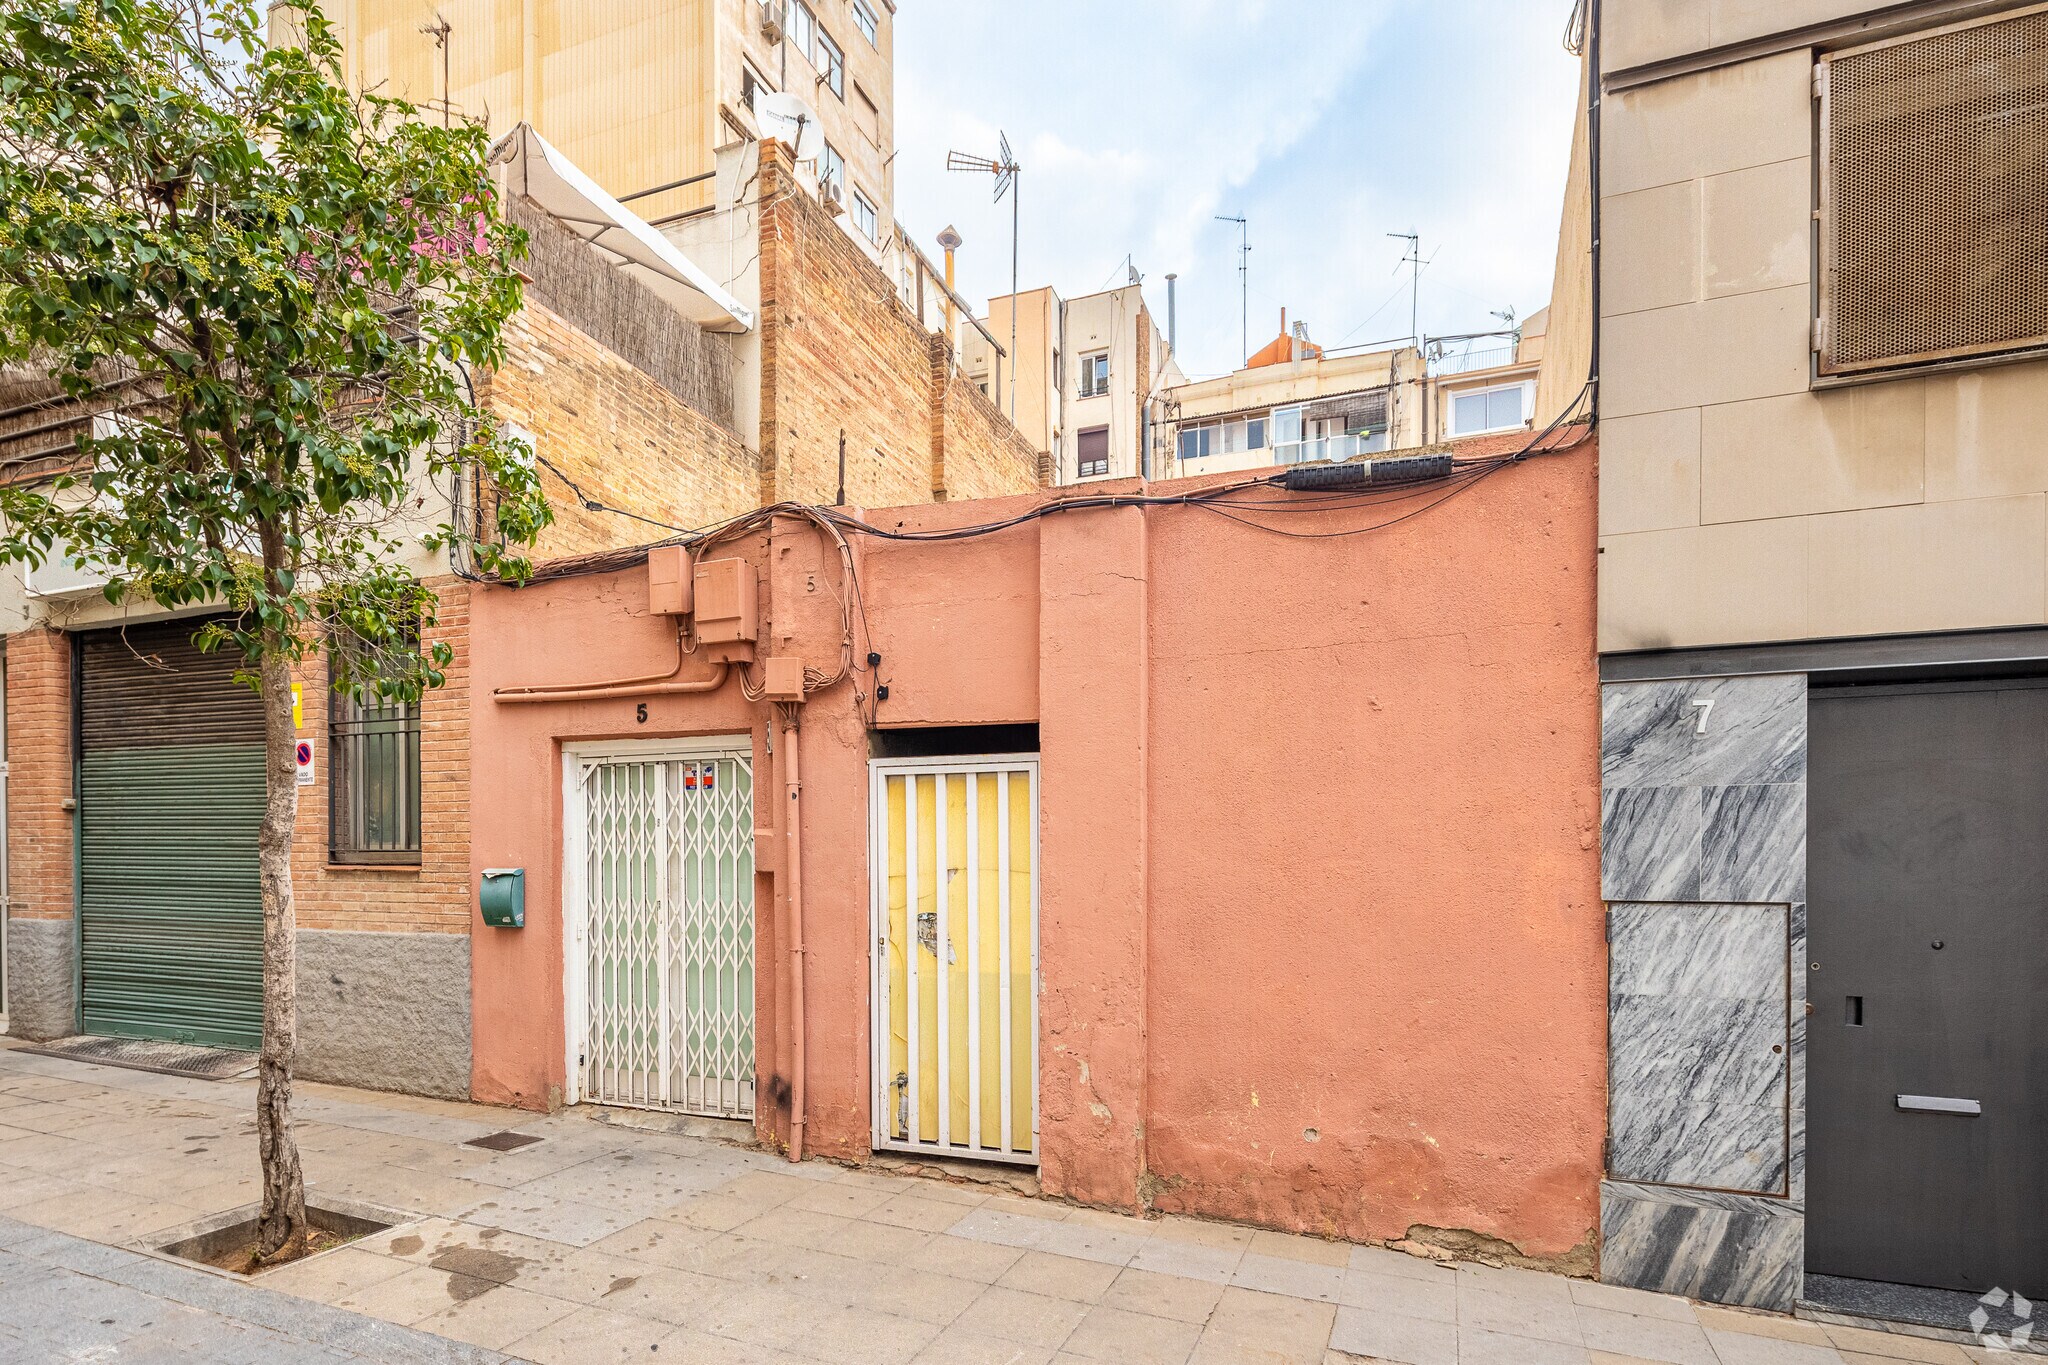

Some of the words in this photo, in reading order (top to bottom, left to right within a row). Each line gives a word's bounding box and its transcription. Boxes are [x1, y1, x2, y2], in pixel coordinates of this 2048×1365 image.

[807, 575, 815, 592] 5
[636, 703, 648, 723] 5
[1692, 699, 1716, 734] 7
